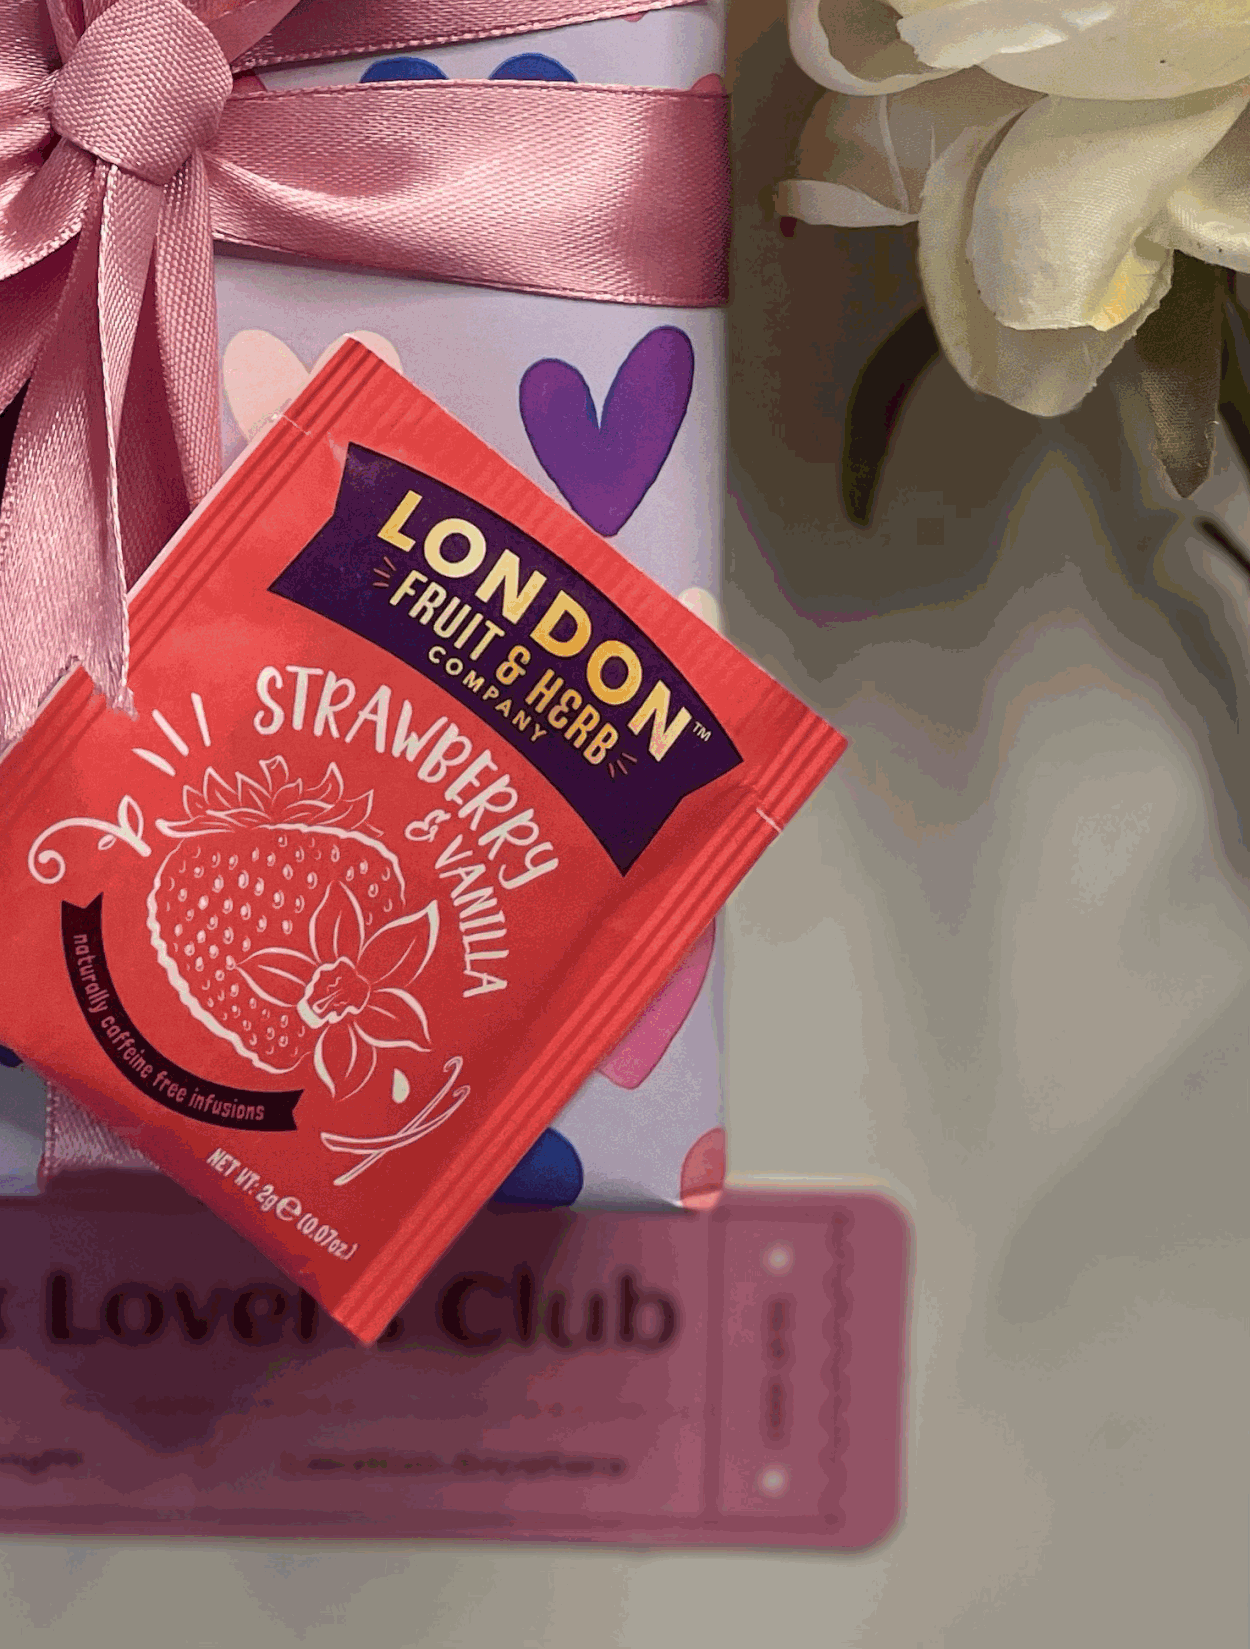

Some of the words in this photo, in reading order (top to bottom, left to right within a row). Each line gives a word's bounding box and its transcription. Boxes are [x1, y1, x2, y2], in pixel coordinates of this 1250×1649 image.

[377, 489, 691, 762] LONDON
[389, 569, 505, 661] FRUIT
[496, 645, 532, 686] &
[525, 668, 620, 766] HERB
[428, 645, 547, 743] COMPANY
[254, 664, 559, 890] STRAWBERRY
[404, 809, 451, 843] &
[435, 834, 510, 998] VANILLA
[73, 933, 109, 1014] naturally
[101, 1015, 154, 1079] caffeine
[152, 1070, 187, 1102] free
[188, 1087, 265, 1121] infusions
[206, 1147, 242, 1177] NET
[440, 1265, 680, 1348] Club
